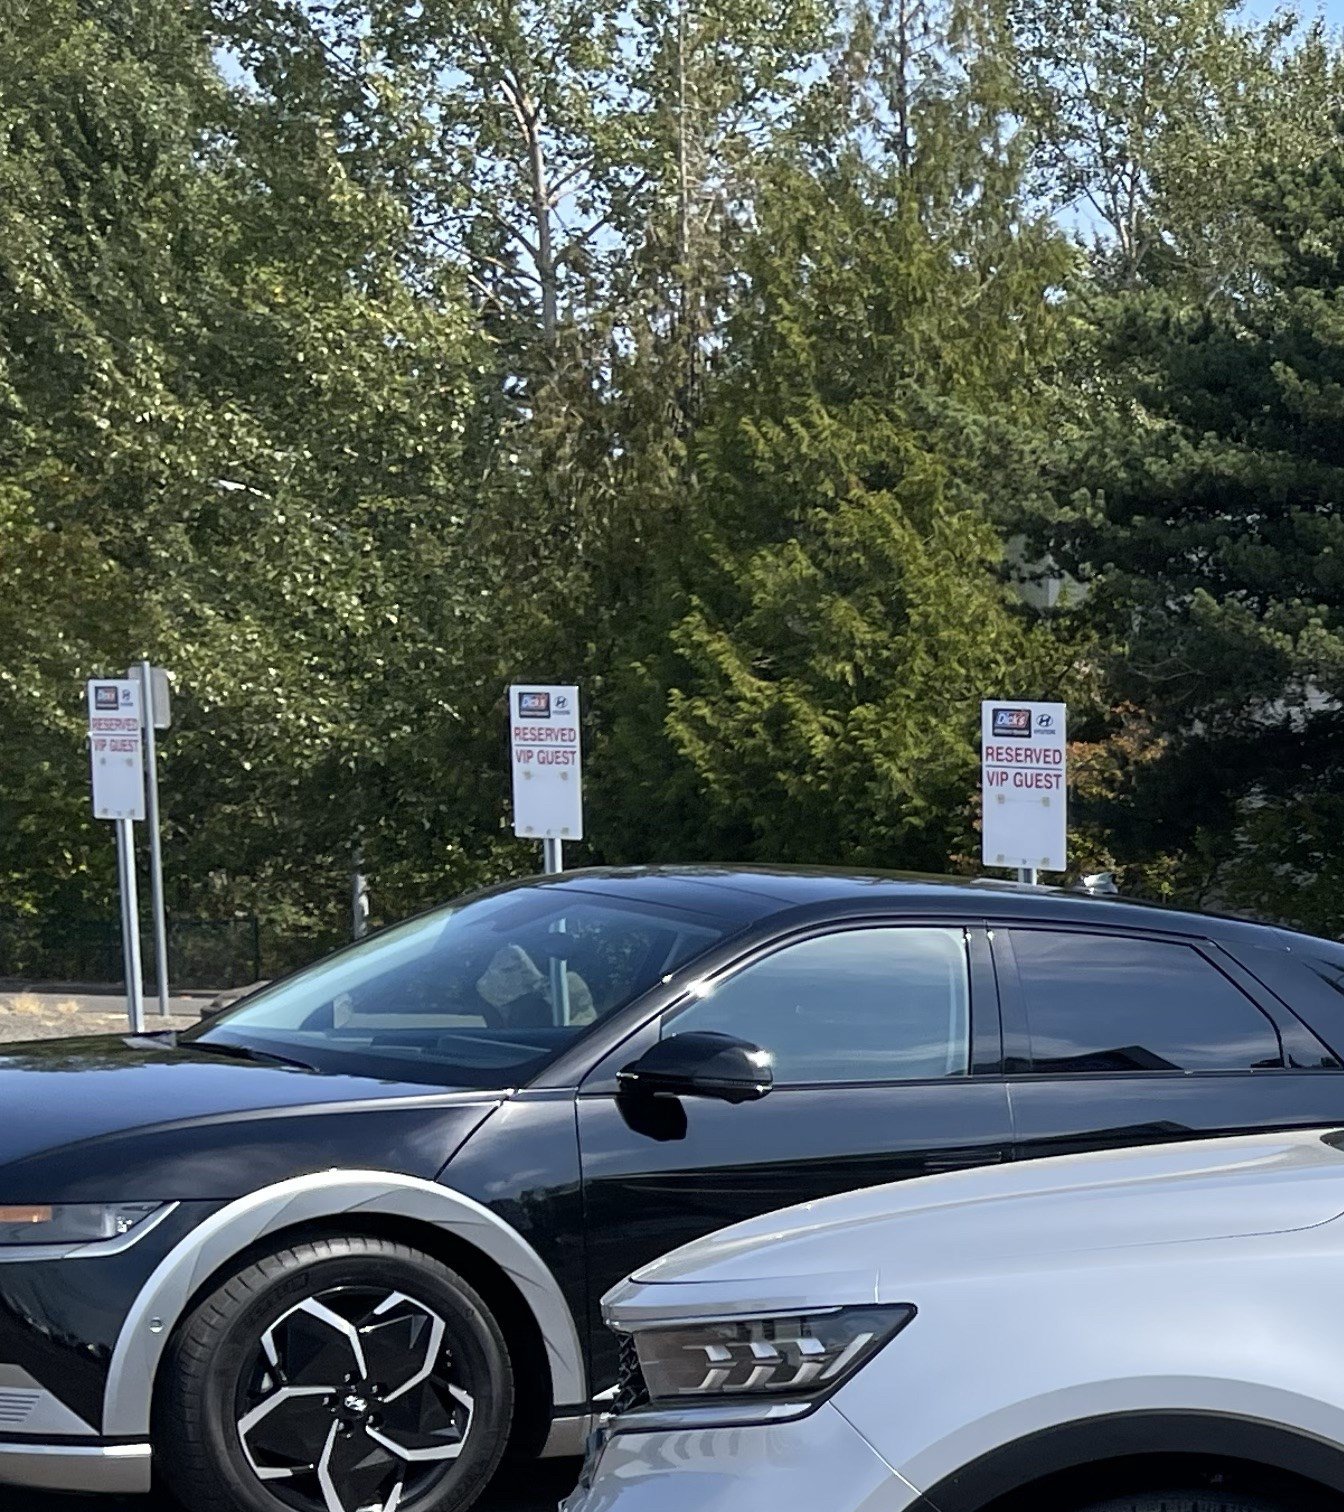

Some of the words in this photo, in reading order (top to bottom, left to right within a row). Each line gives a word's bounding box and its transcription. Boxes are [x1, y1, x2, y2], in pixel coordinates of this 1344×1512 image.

[513, 726, 577, 743] RESERVED
[515, 749, 534, 764] VIP
[537, 750, 577, 765] GUEST
[985, 745, 1063, 765] RESERVED
[986, 770, 1009, 787] VIP
[1013, 771, 1063, 790] GUEST
